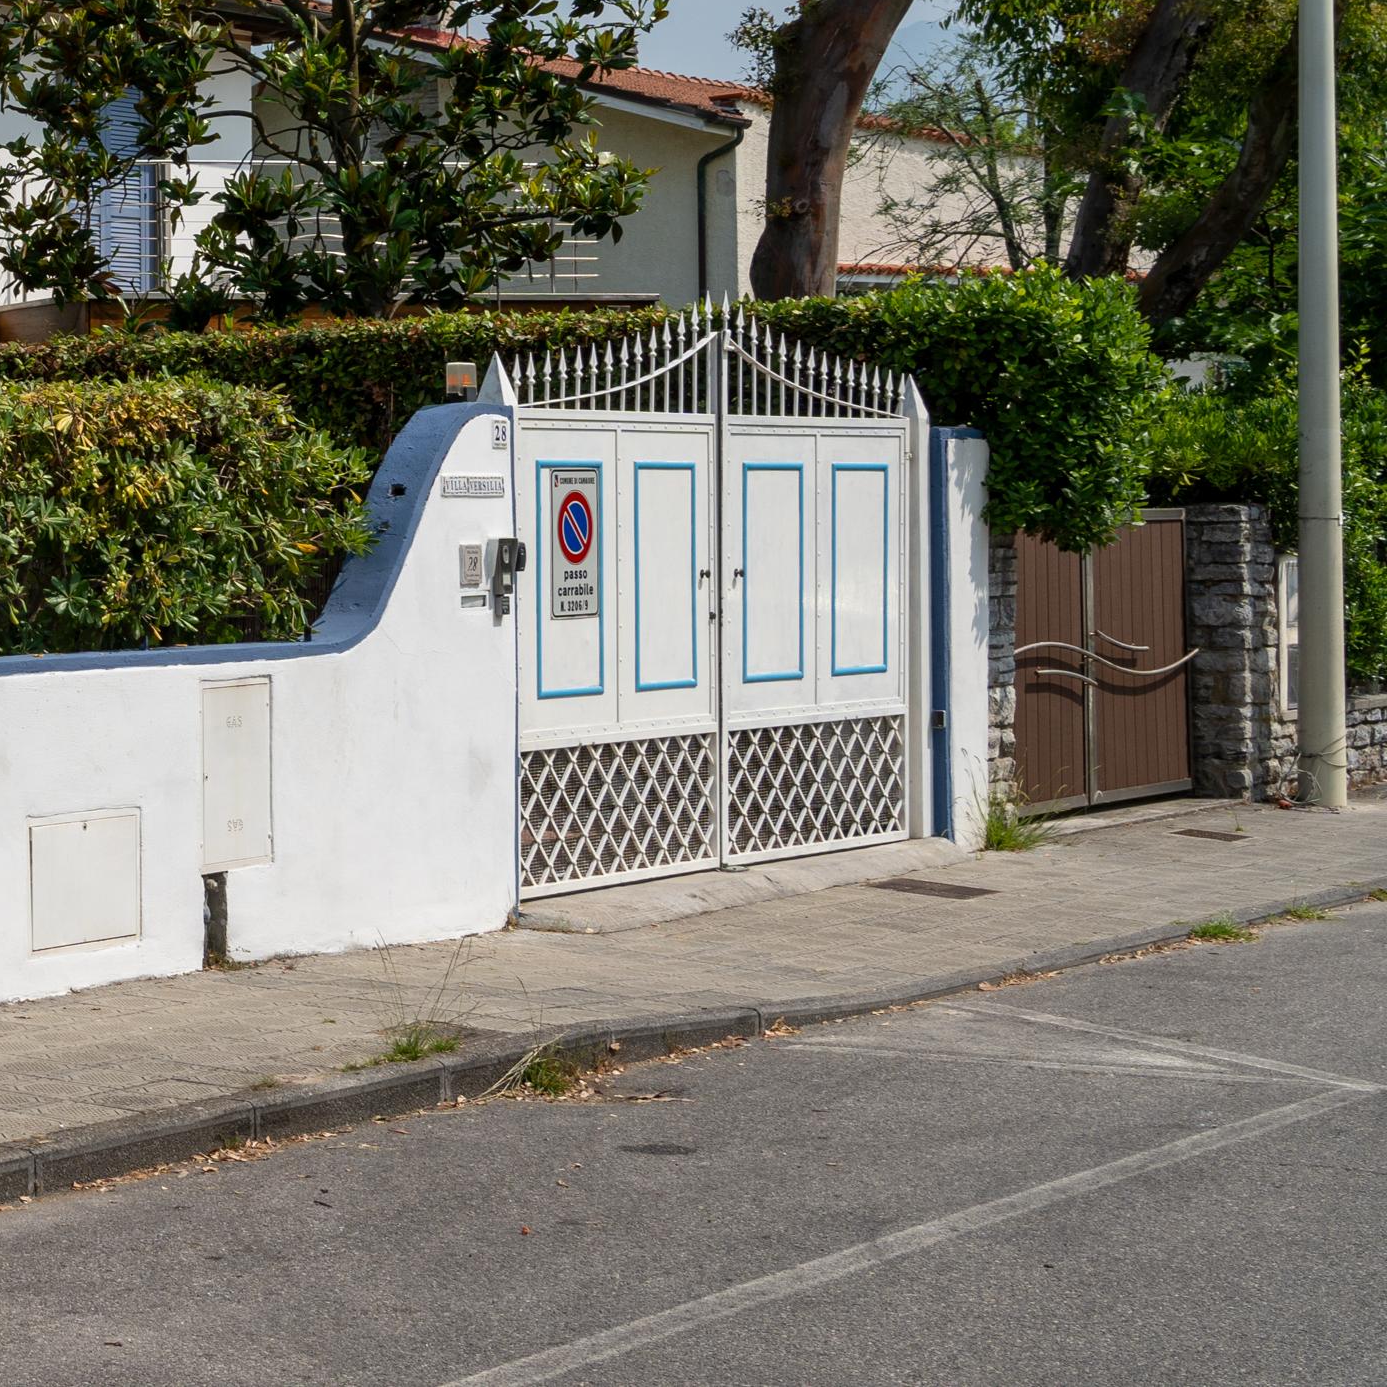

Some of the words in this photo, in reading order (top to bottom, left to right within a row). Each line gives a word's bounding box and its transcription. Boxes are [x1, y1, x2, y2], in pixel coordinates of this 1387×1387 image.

[495, 425, 507, 442] 28
[445, 480, 468, 491] VILLA
[469, 480, 502, 491] VERSILIA
[564, 570, 588, 582] passo
[558, 583, 593, 597] carrabile
[567, 599, 588, 612] 3206/9
[226, 715, 243, 728] GAS
[226, 818, 244, 832] GAS
